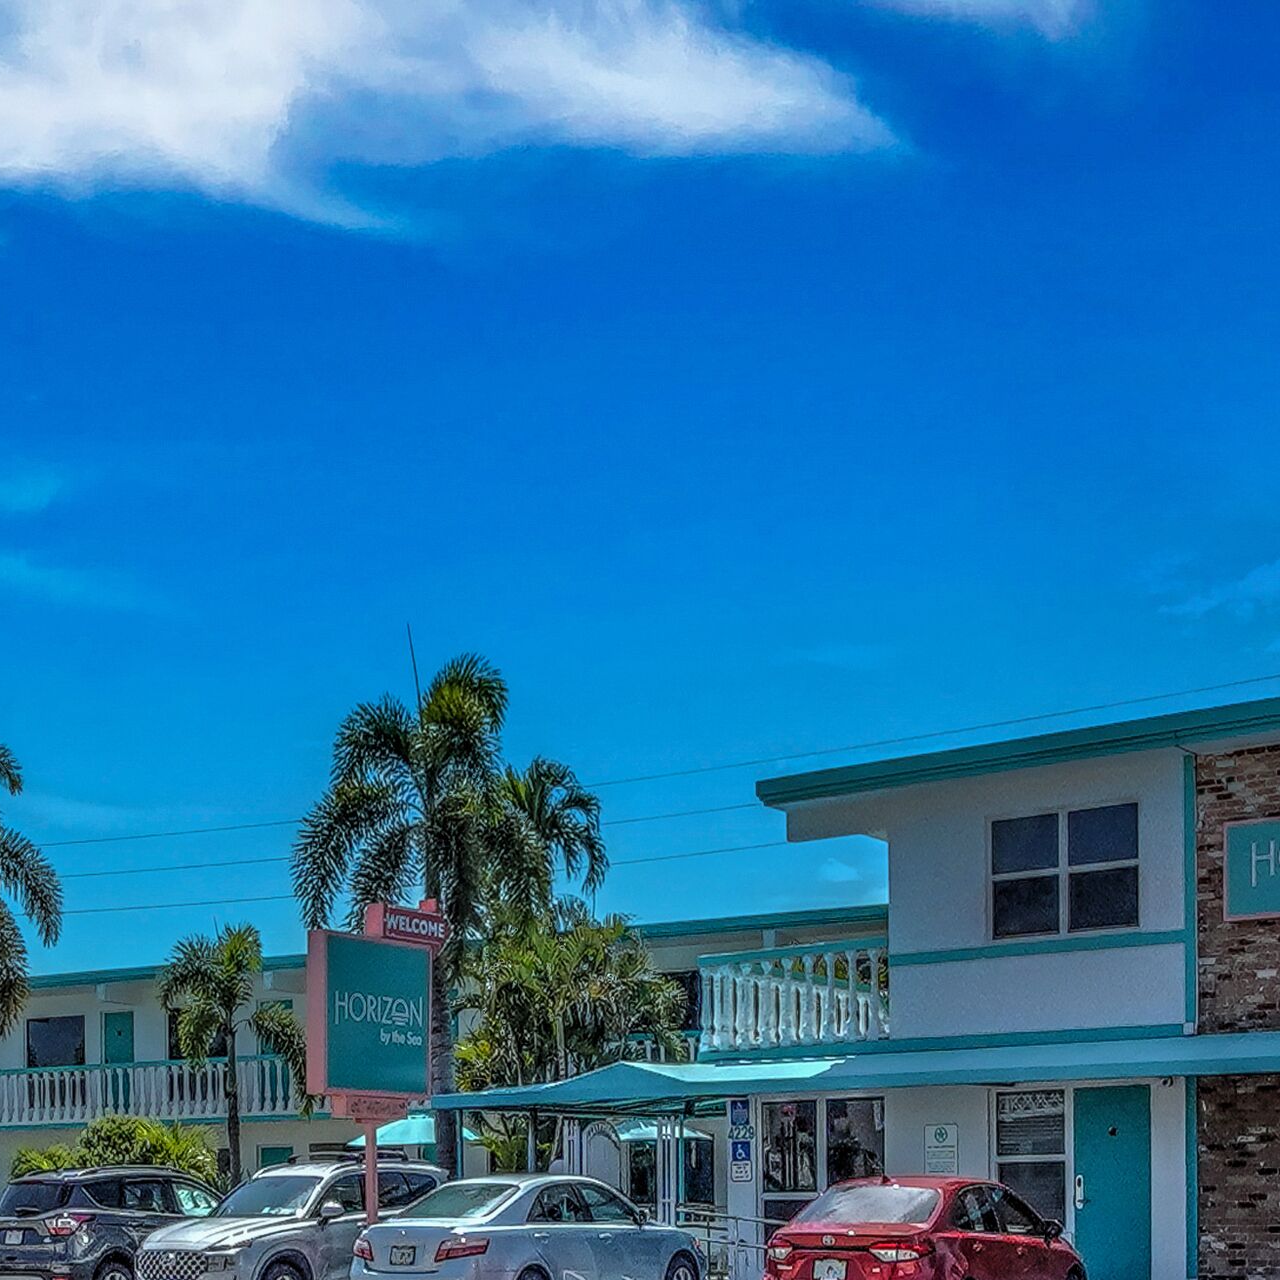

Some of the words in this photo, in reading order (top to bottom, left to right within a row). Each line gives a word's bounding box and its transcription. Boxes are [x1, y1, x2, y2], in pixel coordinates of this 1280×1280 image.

[386, 913, 446, 938] WELCOME
[334, 990, 423, 1027] HORIZON
[380, 1028, 391, 1045] by
[392, 1030, 406, 1043] the
[407, 1031, 423, 1046] Sea
[728, 1125, 755, 1140] 4229
